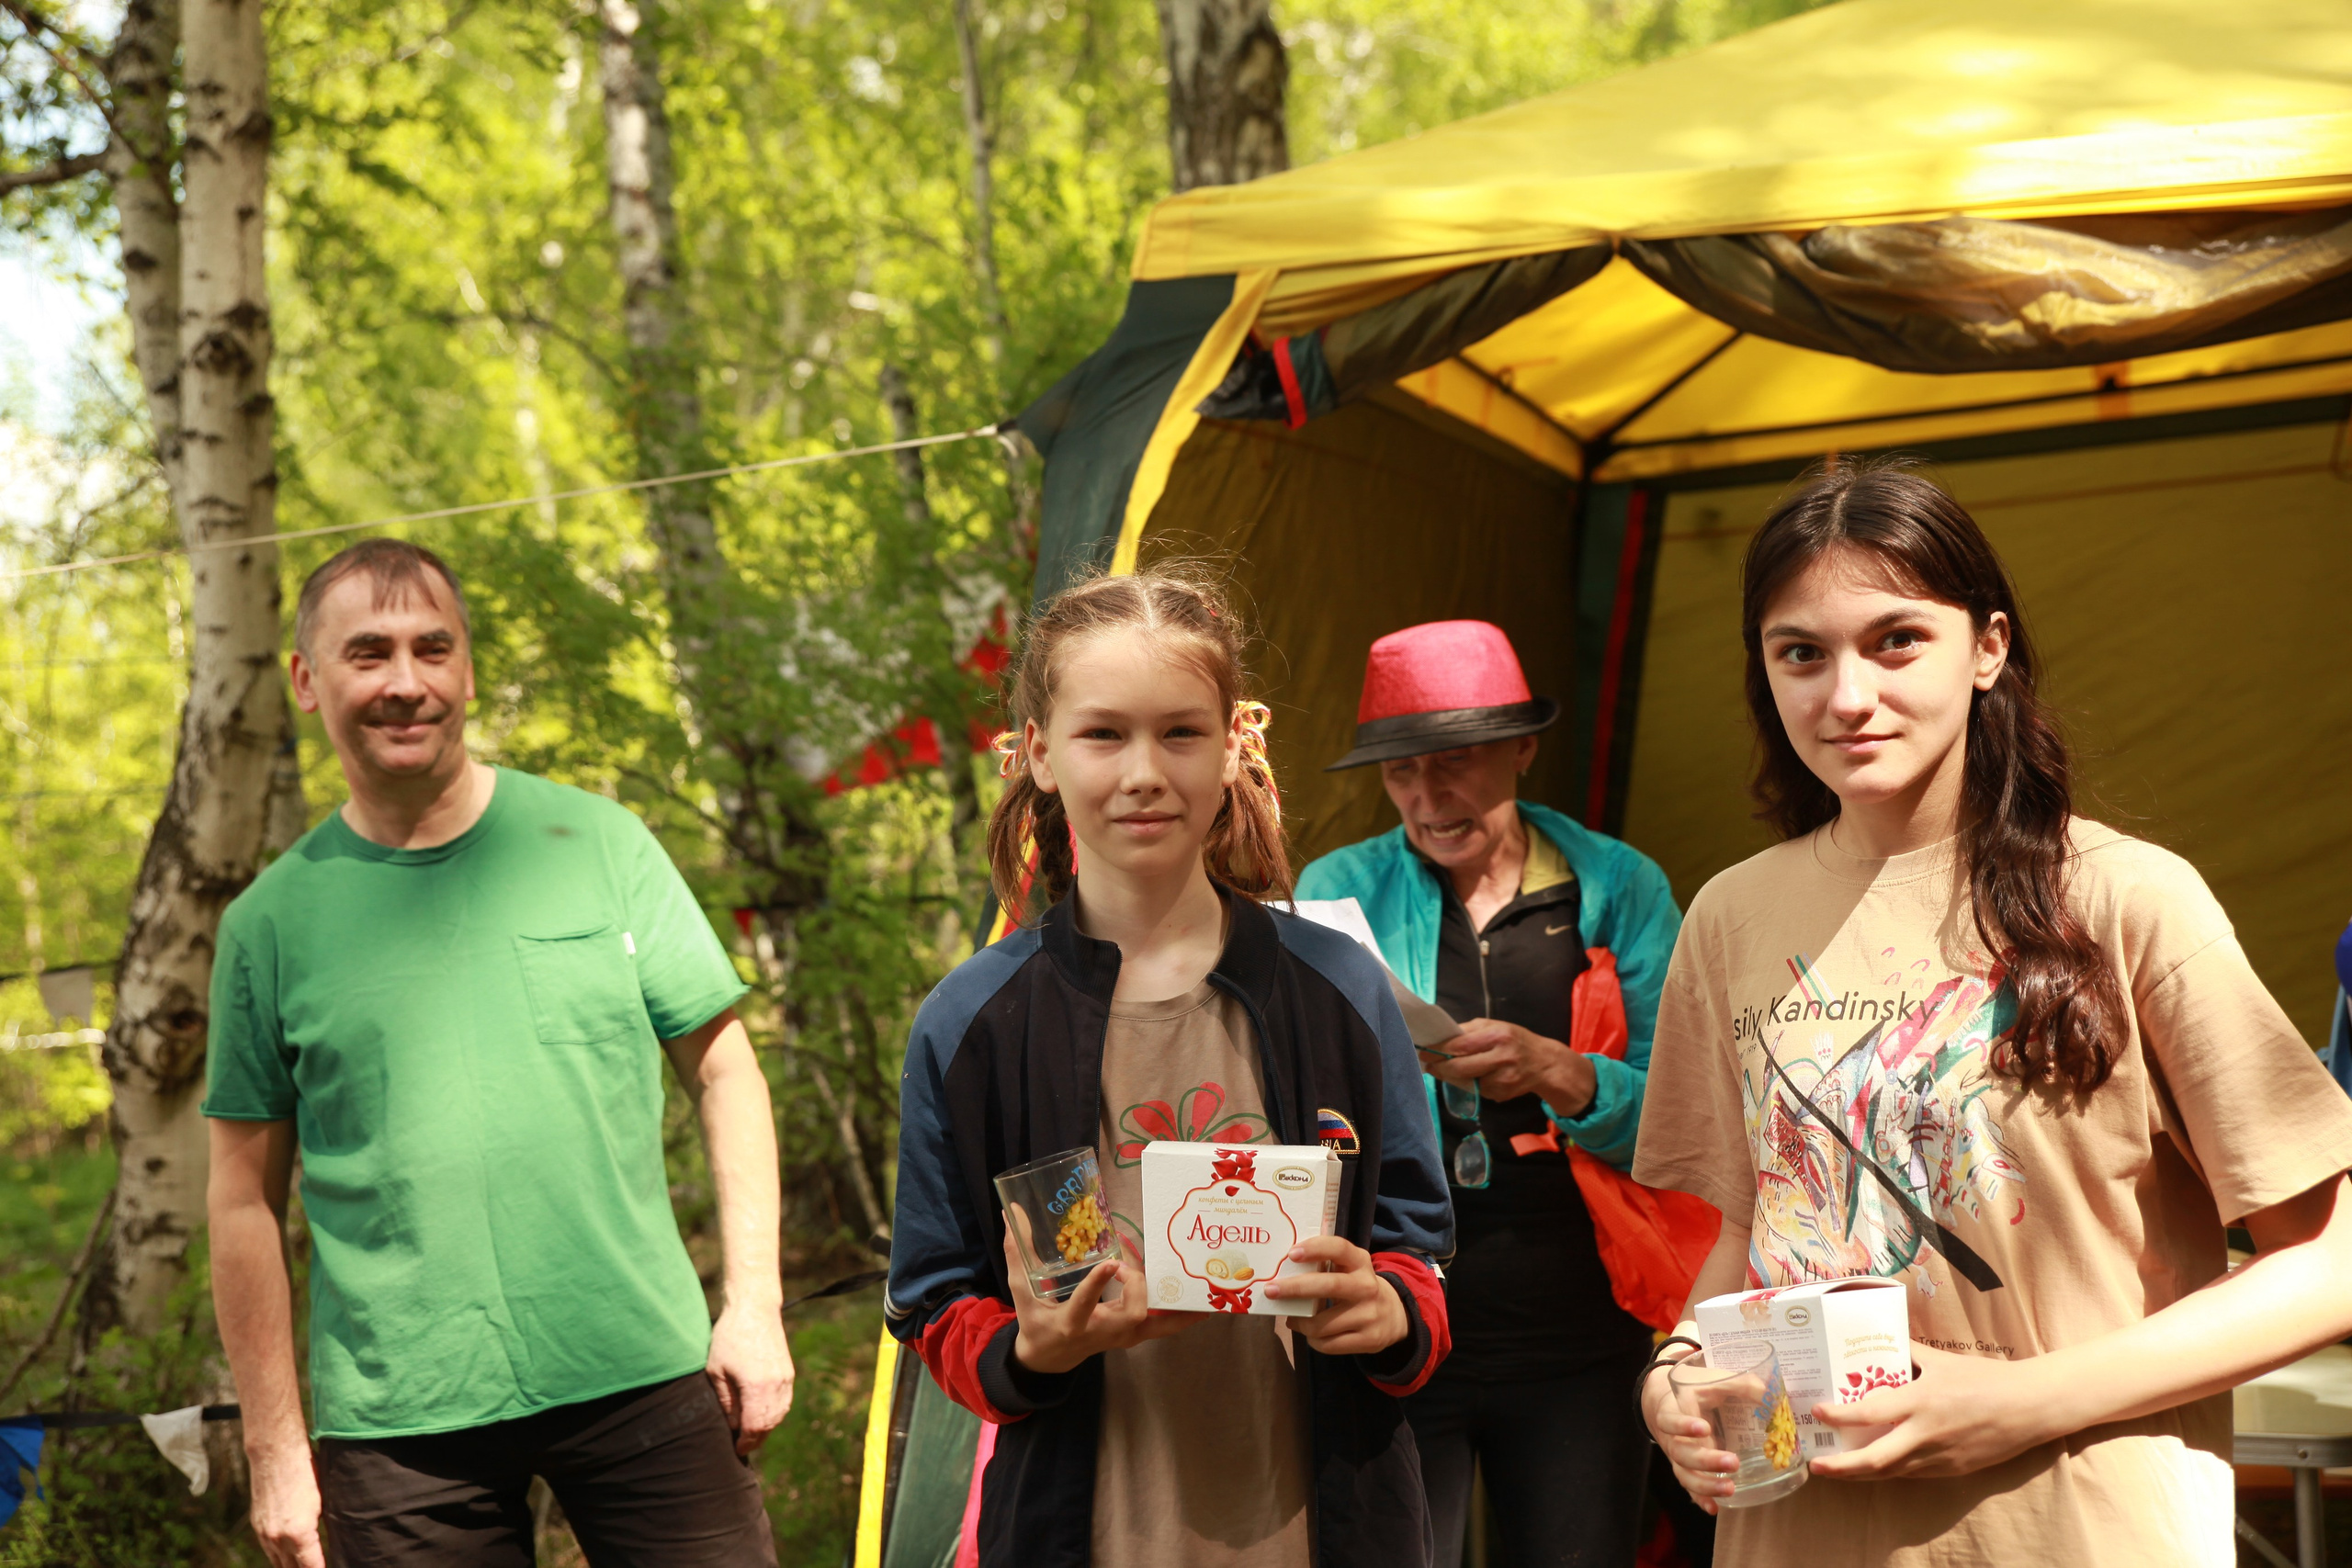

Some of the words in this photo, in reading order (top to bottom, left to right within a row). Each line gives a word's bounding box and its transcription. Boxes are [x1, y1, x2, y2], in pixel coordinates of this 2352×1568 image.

[1767, 990, 1940, 1030] Kandinsky
[1198, 1197, 1229, 1205] конфеты
[1187, 1213, 1271, 1249] Адель
[1918, 1337, 1973, 1351] Tretyakov
[1974, 1340, 2015, 1357] Gallery
